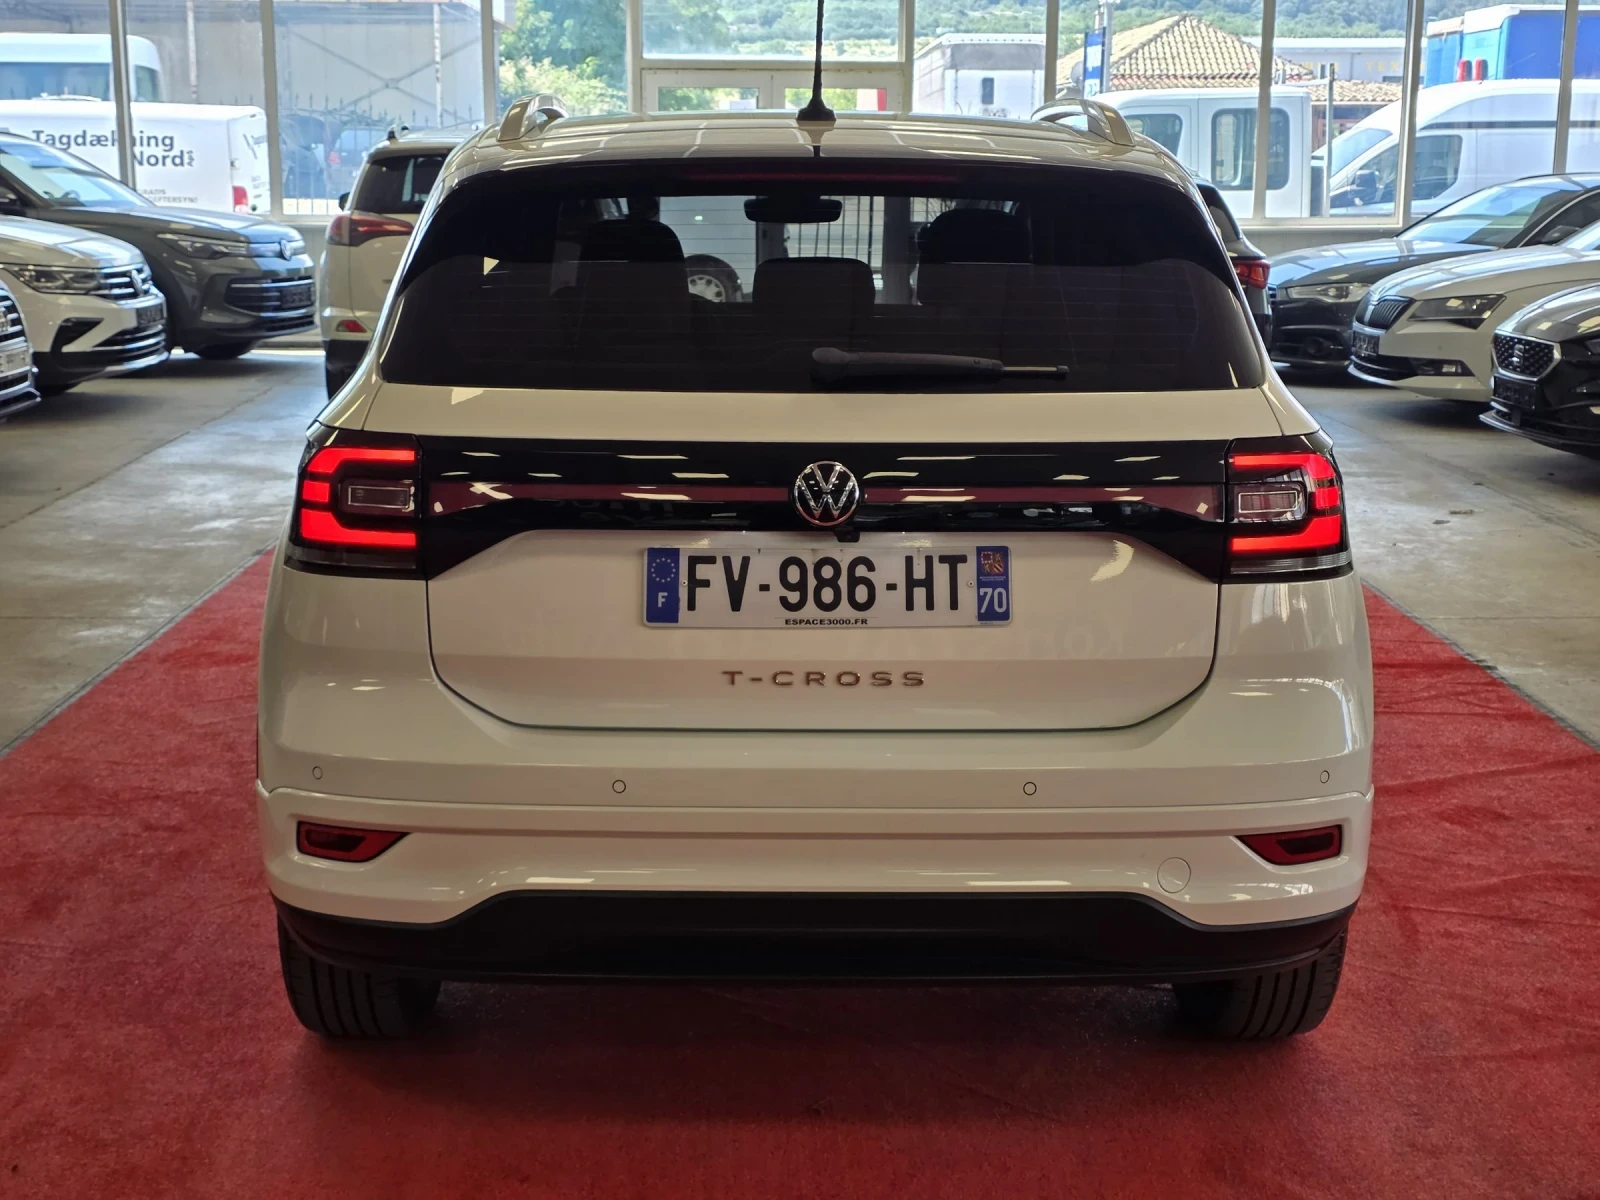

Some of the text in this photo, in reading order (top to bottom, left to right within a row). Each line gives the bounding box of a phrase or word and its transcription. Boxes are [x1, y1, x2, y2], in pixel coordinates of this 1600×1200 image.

[687, 554, 968, 613] FV-986-HT
[657, 592, 668, 607] F
[979, 587, 1008, 613] 70
[784, 617, 869, 626] ESPACE3000.FR
[721, 670, 926, 688] T-CROSS
